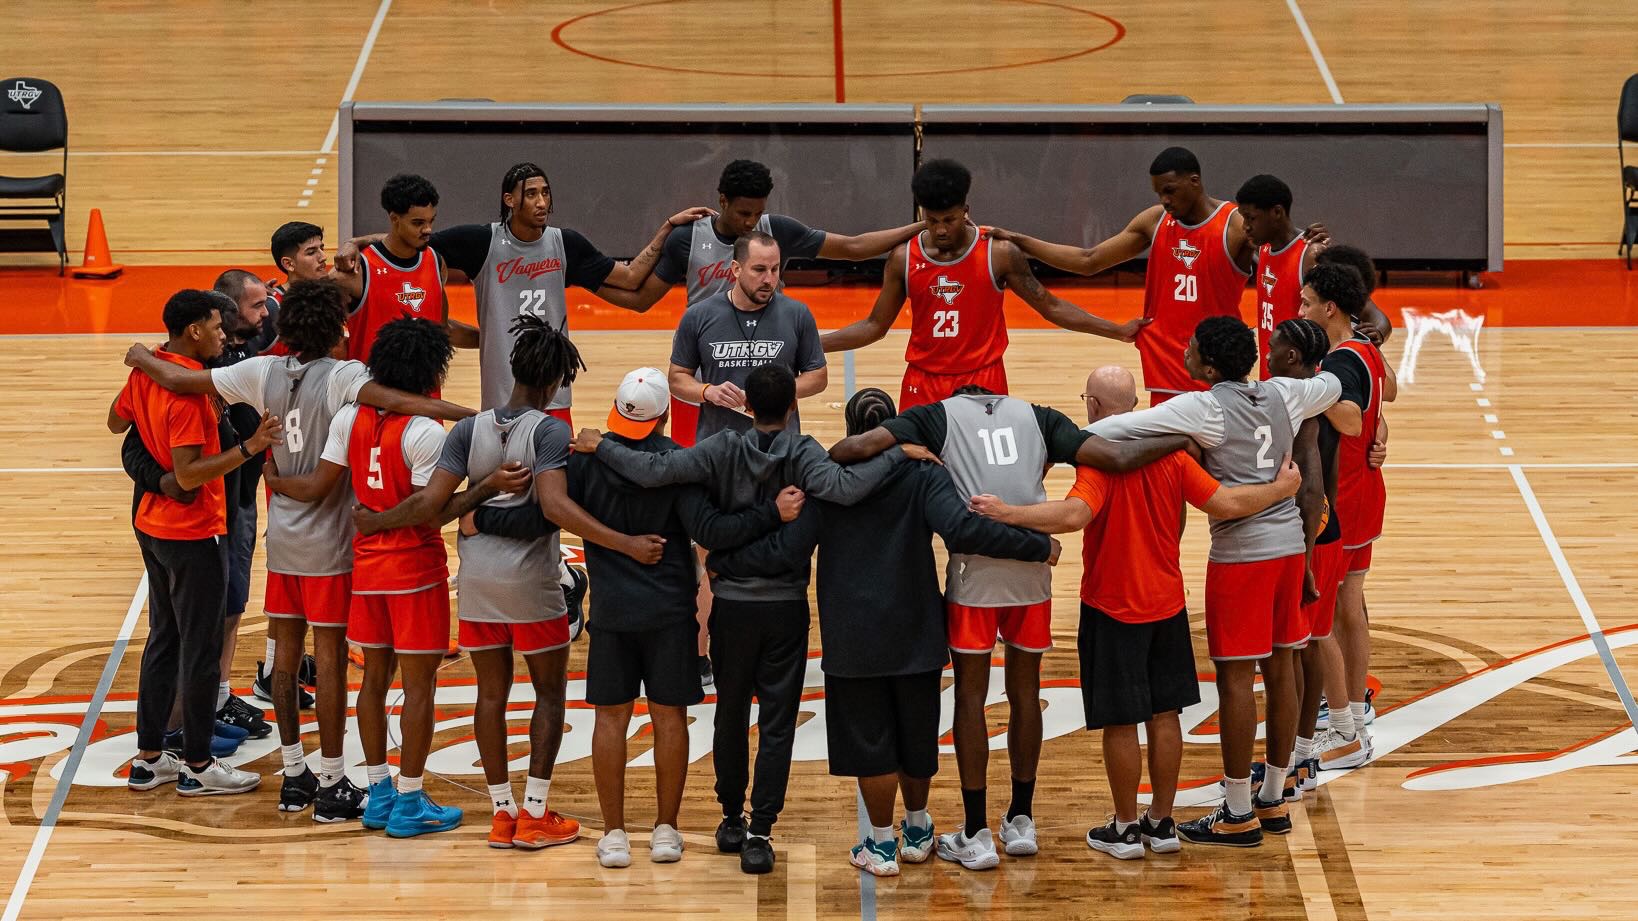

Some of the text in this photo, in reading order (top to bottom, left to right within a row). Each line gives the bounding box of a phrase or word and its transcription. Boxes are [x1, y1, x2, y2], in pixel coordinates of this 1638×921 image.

[8, 89, 42, 99] UTRGV
[519, 289, 546, 316] 22
[1174, 274, 1198, 302] 20
[933, 311, 959, 337] 23
[1262, 301, 1274, 331] 35
[711, 340, 783, 359] UTRGV
[286, 408, 304, 453] 8
[978, 427, 1019, 465] 10
[1254, 425, 1275, 468] 2
[367, 447, 383, 489] 5
